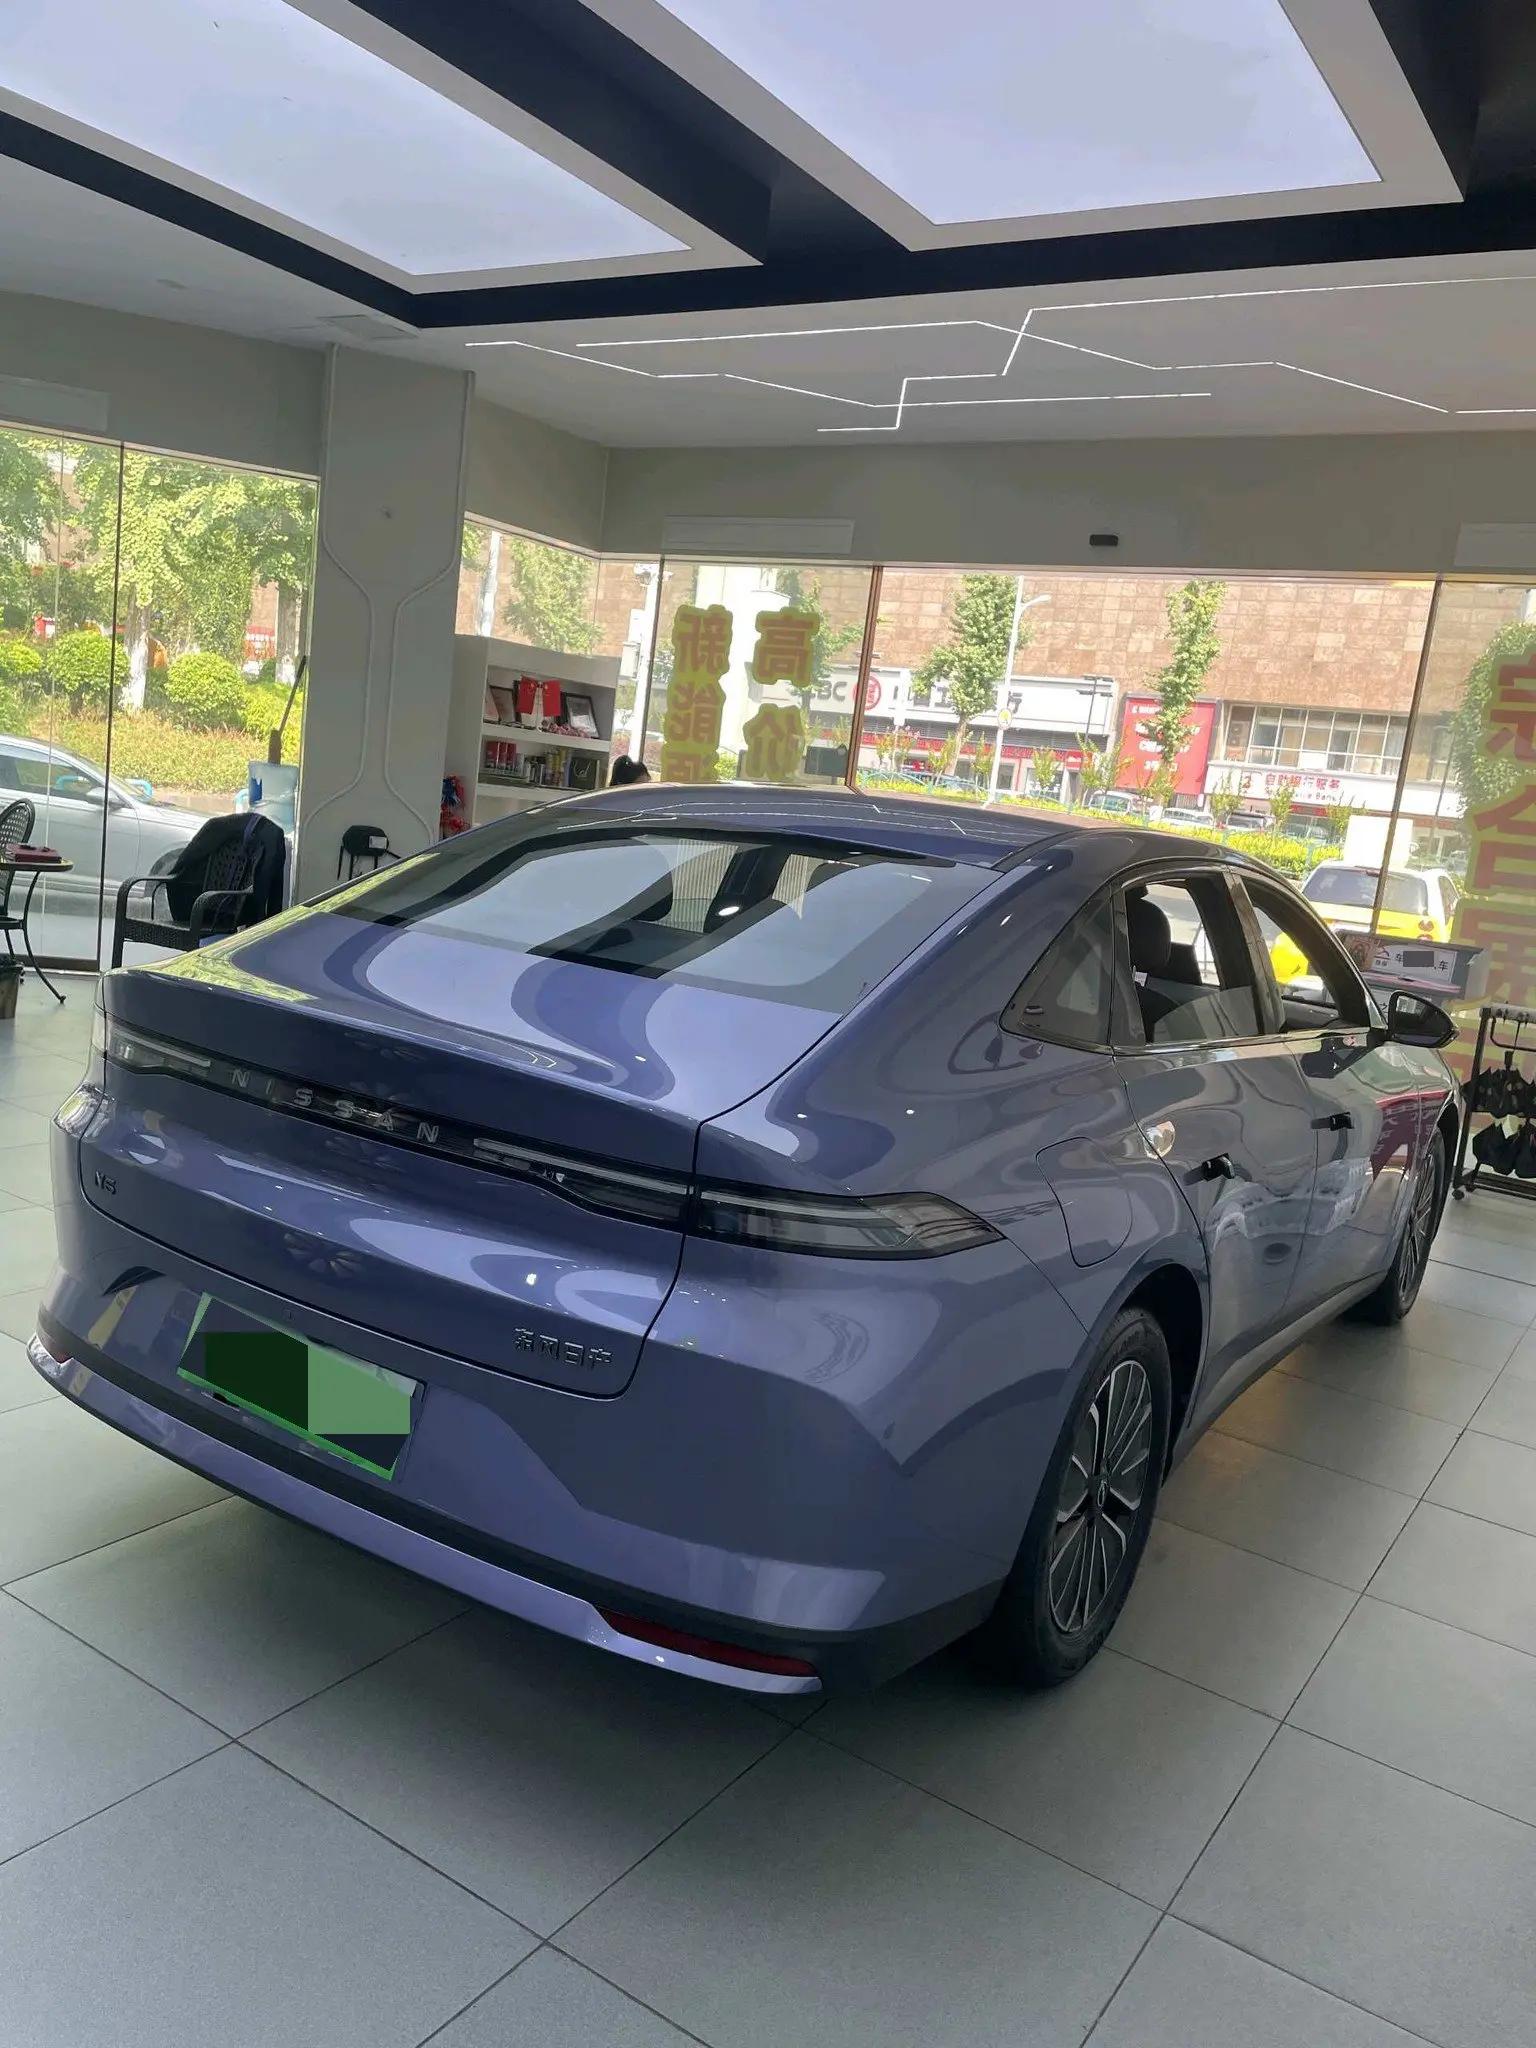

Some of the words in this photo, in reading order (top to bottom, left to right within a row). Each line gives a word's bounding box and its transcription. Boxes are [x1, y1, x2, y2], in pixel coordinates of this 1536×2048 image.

[230, 1067, 441, 1144] NISSAN
[513, 1326, 613, 1369] 东风日产
